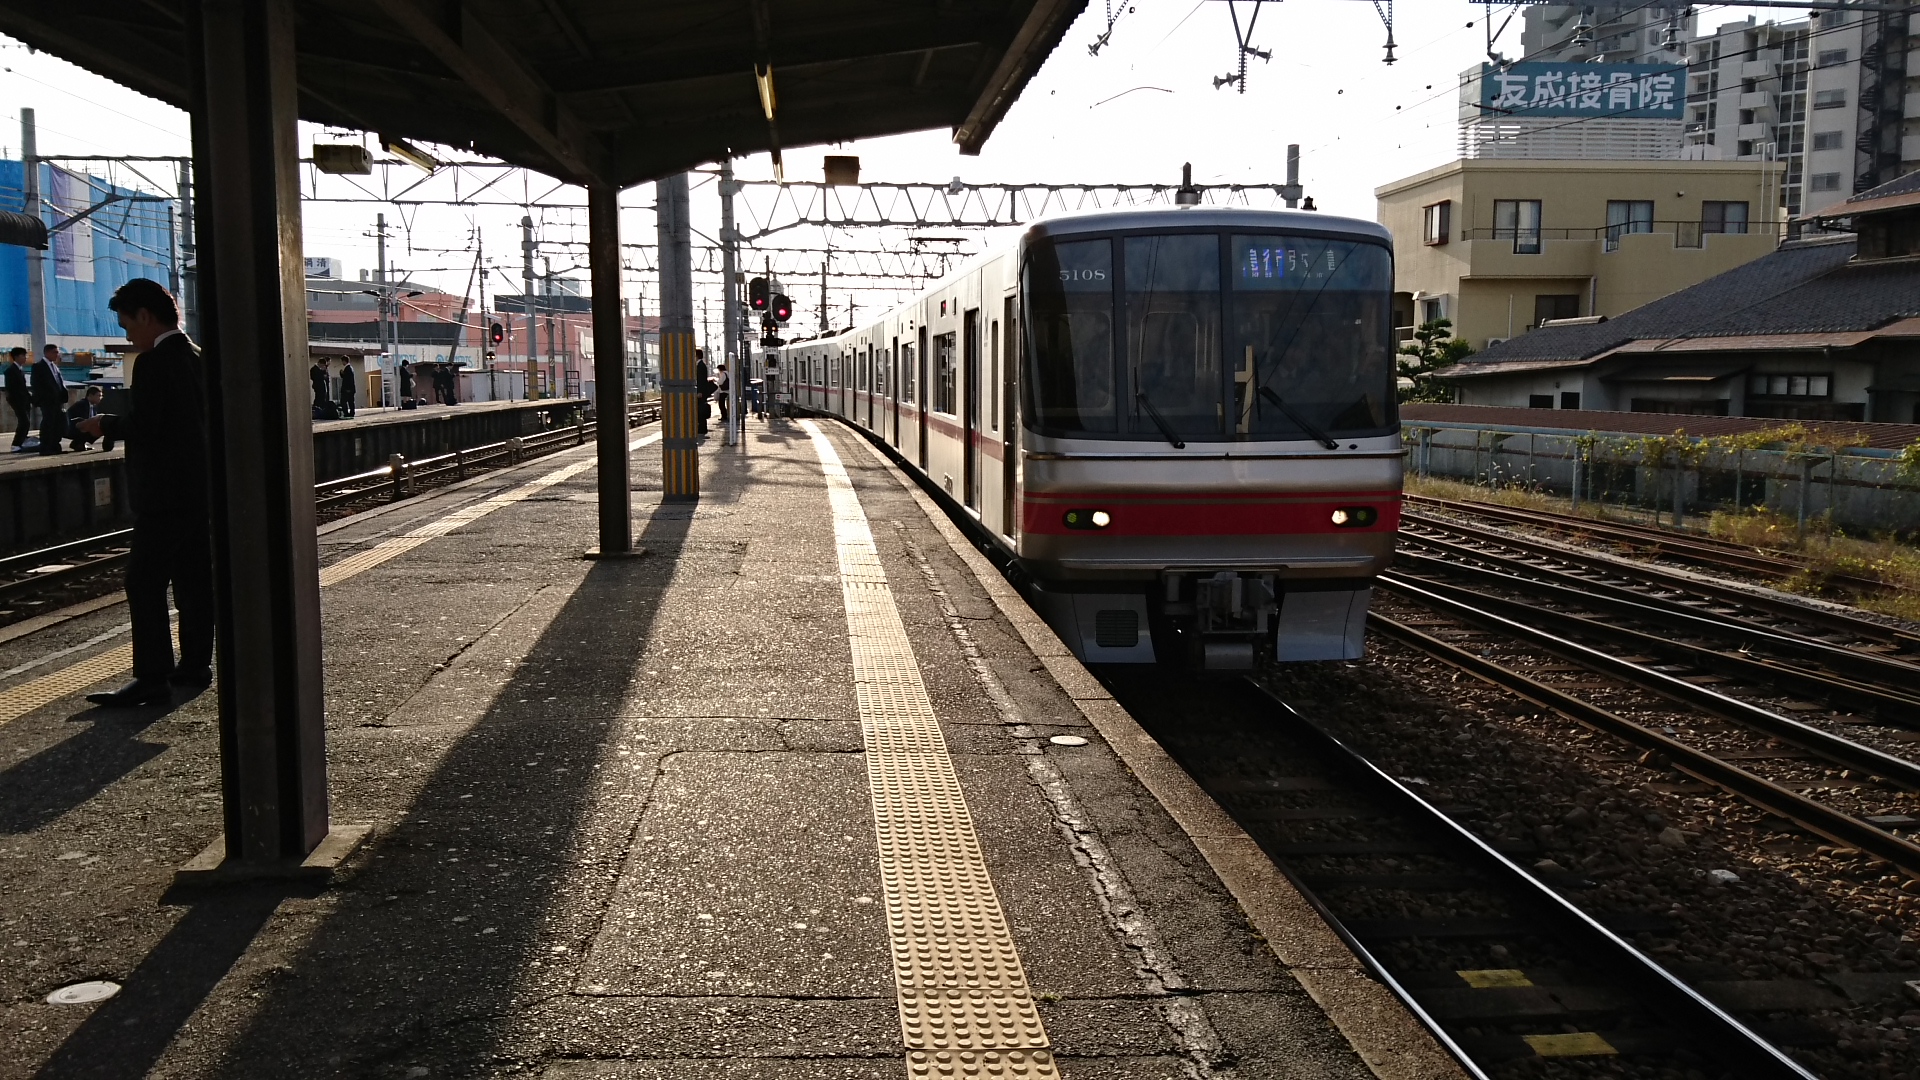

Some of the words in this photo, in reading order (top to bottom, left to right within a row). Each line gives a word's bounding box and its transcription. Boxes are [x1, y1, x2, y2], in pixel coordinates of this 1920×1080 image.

[1492, 71, 1676, 110] 友成接骨院
[1059, 269, 1106, 281] 5108
